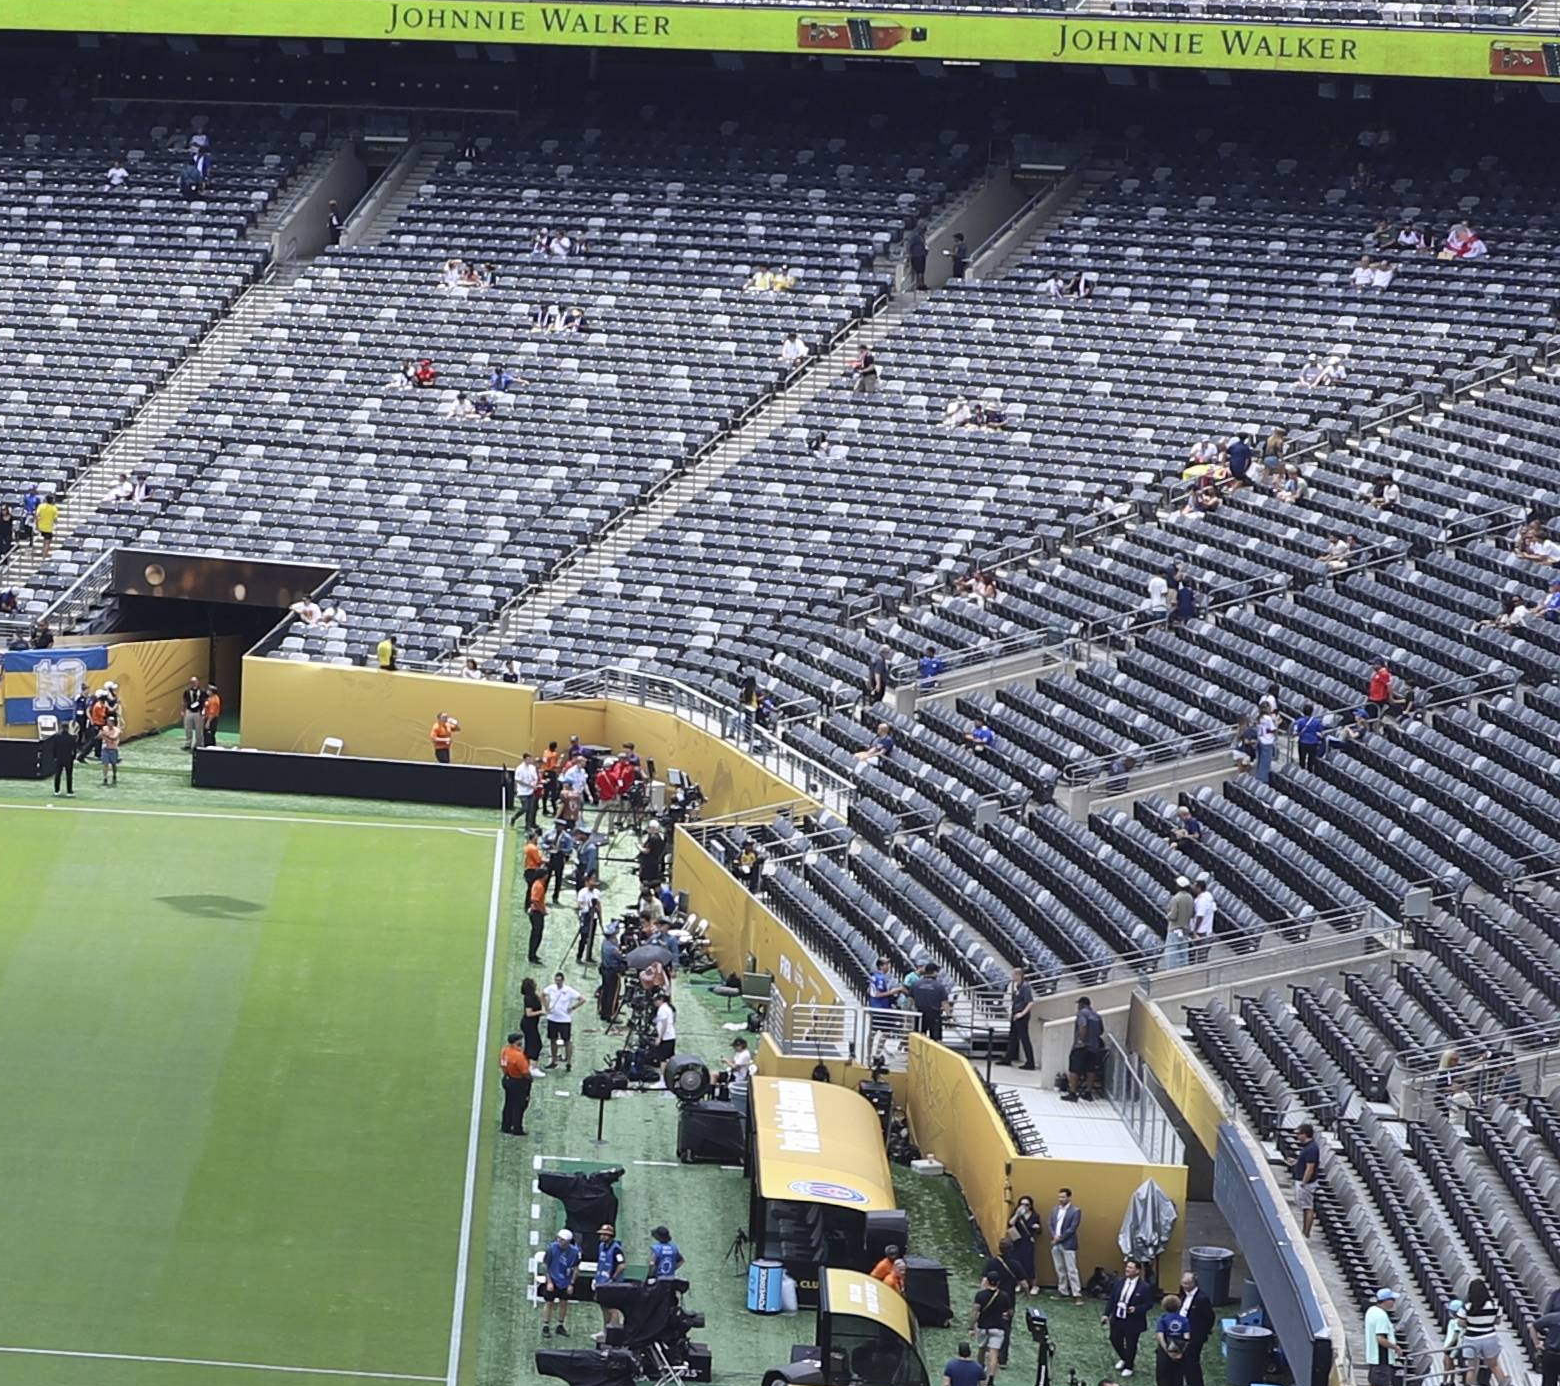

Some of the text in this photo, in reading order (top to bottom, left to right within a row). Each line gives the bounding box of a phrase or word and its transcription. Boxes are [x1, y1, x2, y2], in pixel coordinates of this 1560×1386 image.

[385, 3, 670, 35] JOHNNIE WALKER
[1053, 24, 1357, 60] JOHNNIE WALKER
